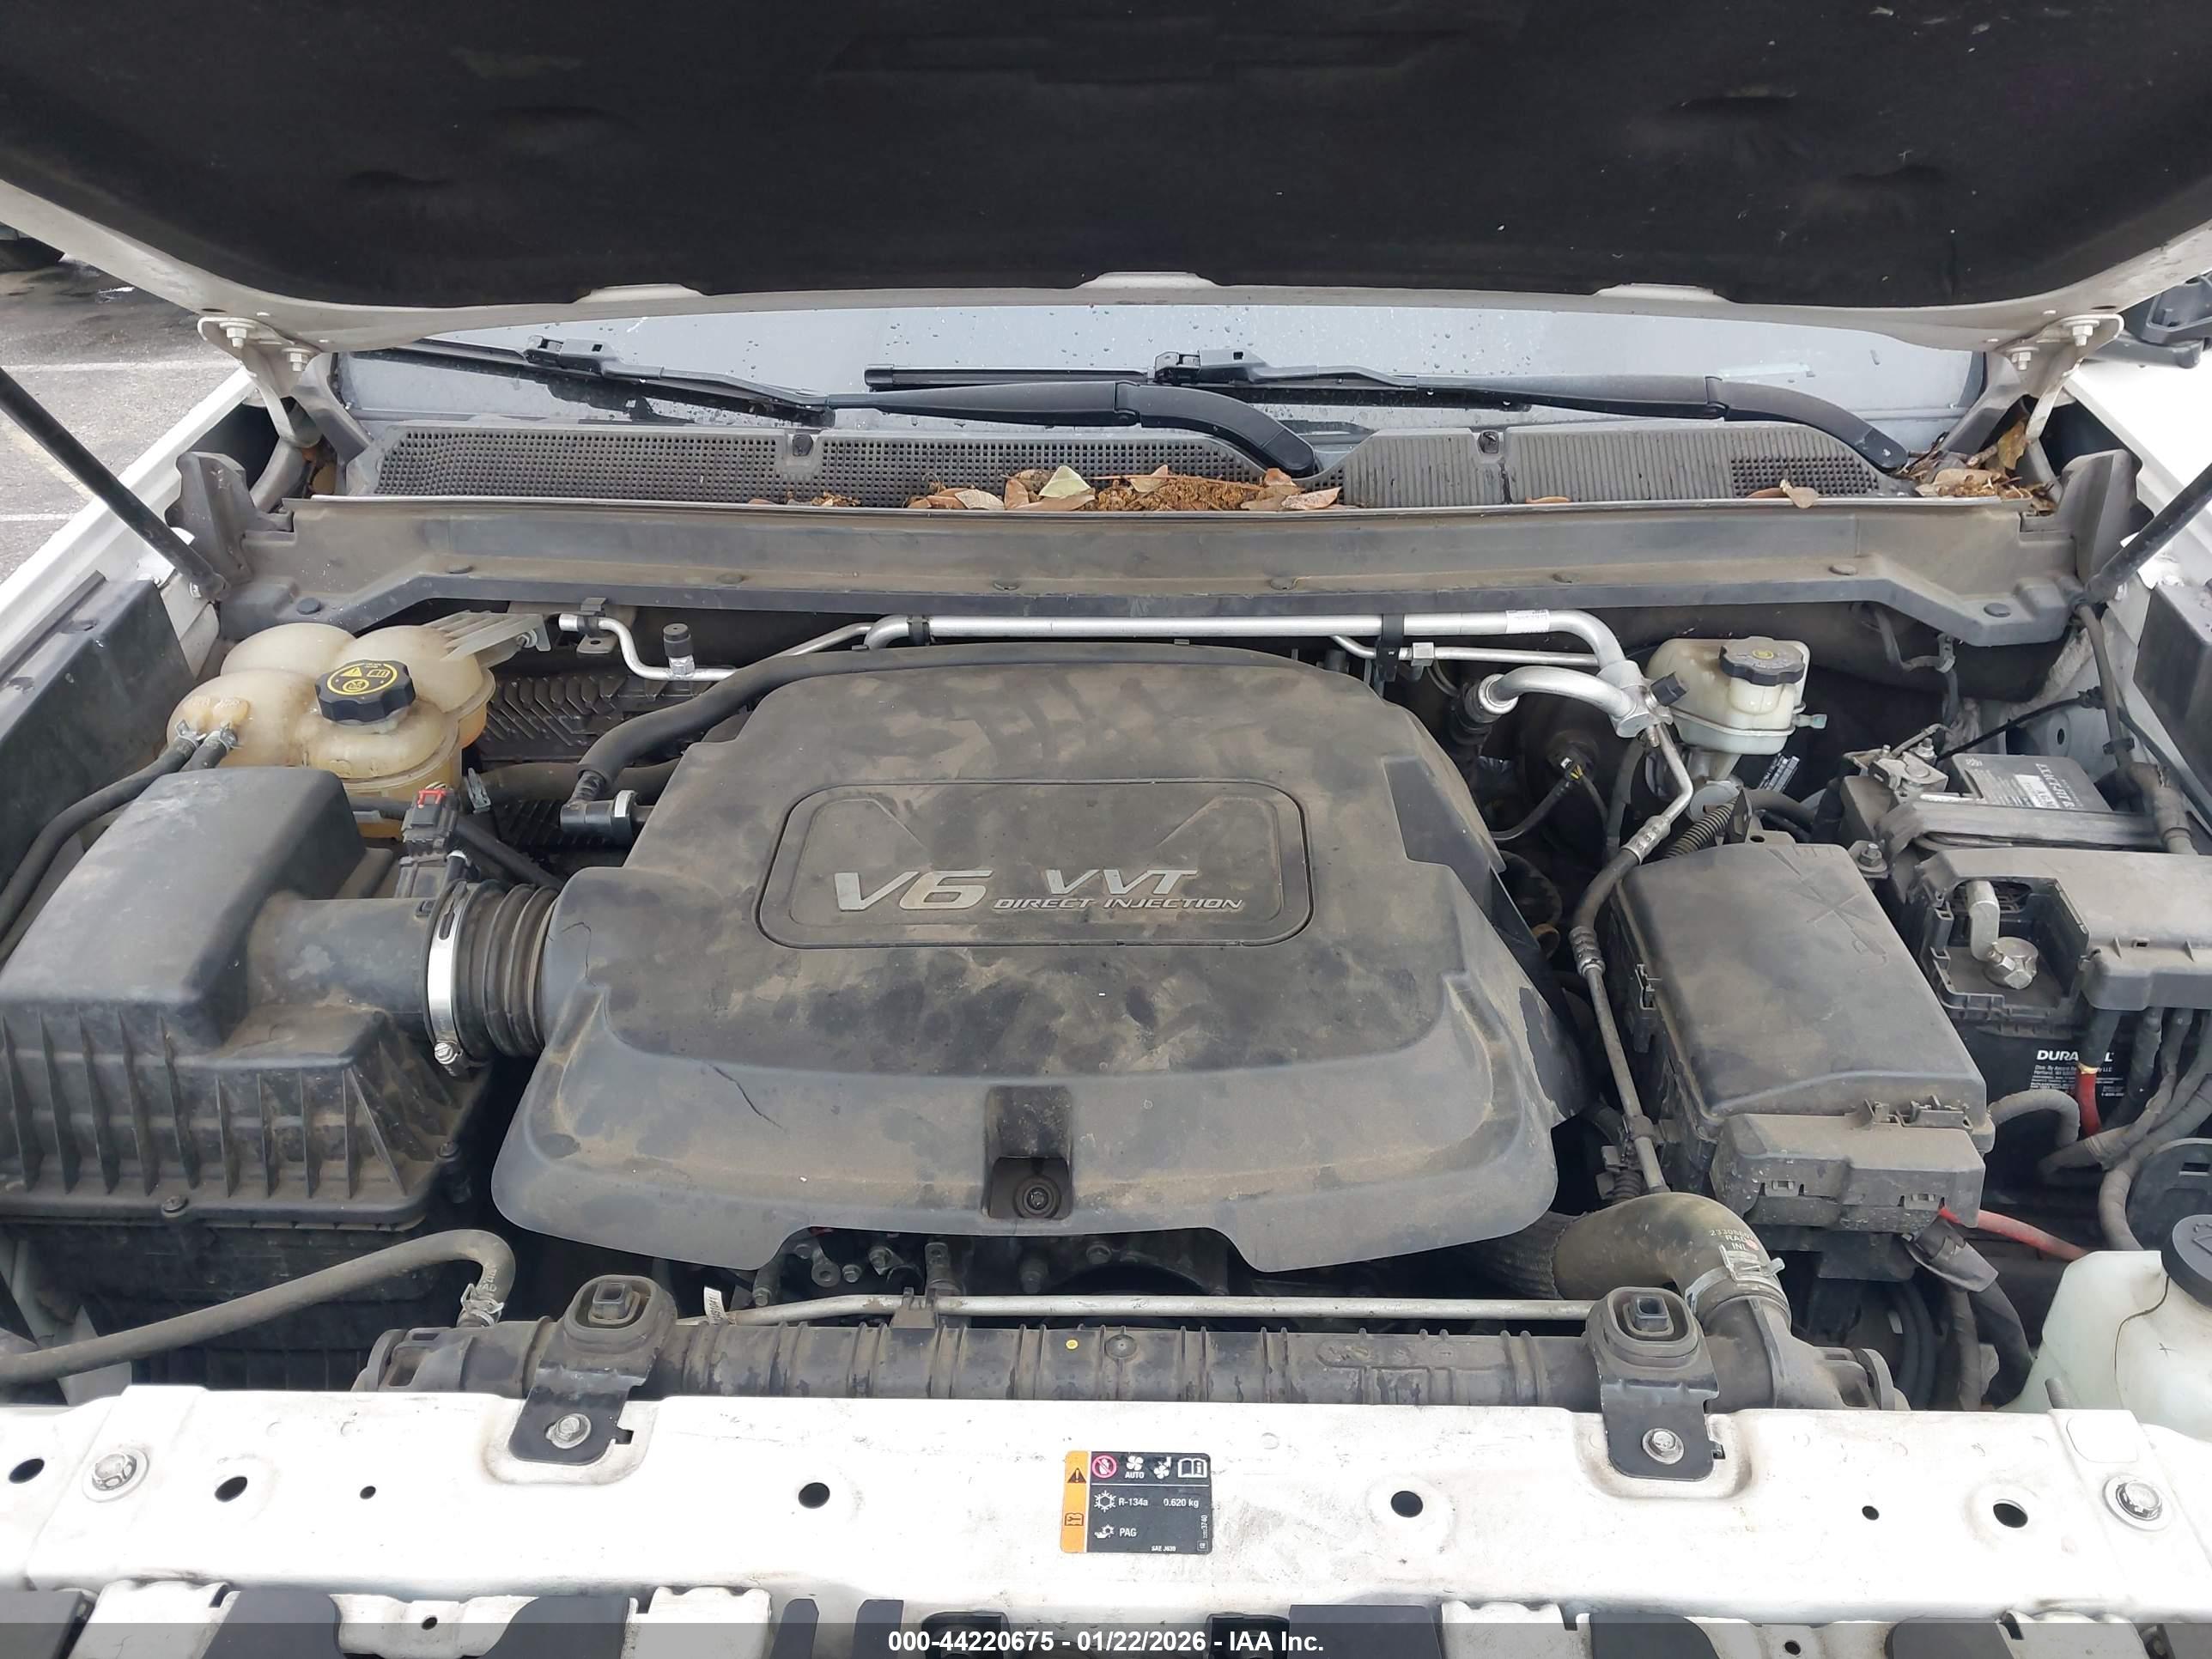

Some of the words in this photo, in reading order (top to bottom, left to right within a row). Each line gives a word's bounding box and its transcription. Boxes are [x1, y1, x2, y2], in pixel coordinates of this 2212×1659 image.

[1046, 870, 1199, 895] VVT
[835, 870, 994, 912] V6
[994, 899, 1095, 909] DIRECT
[1103, 899, 1245, 909] INJECTION
[1118, 1497, 1149, 1506] R-134a
[1163, 1497, 1187, 1507] 0.620
[1188, 1497, 1200, 1509] kg
[1119, 1528, 1138, 1537] PAG
